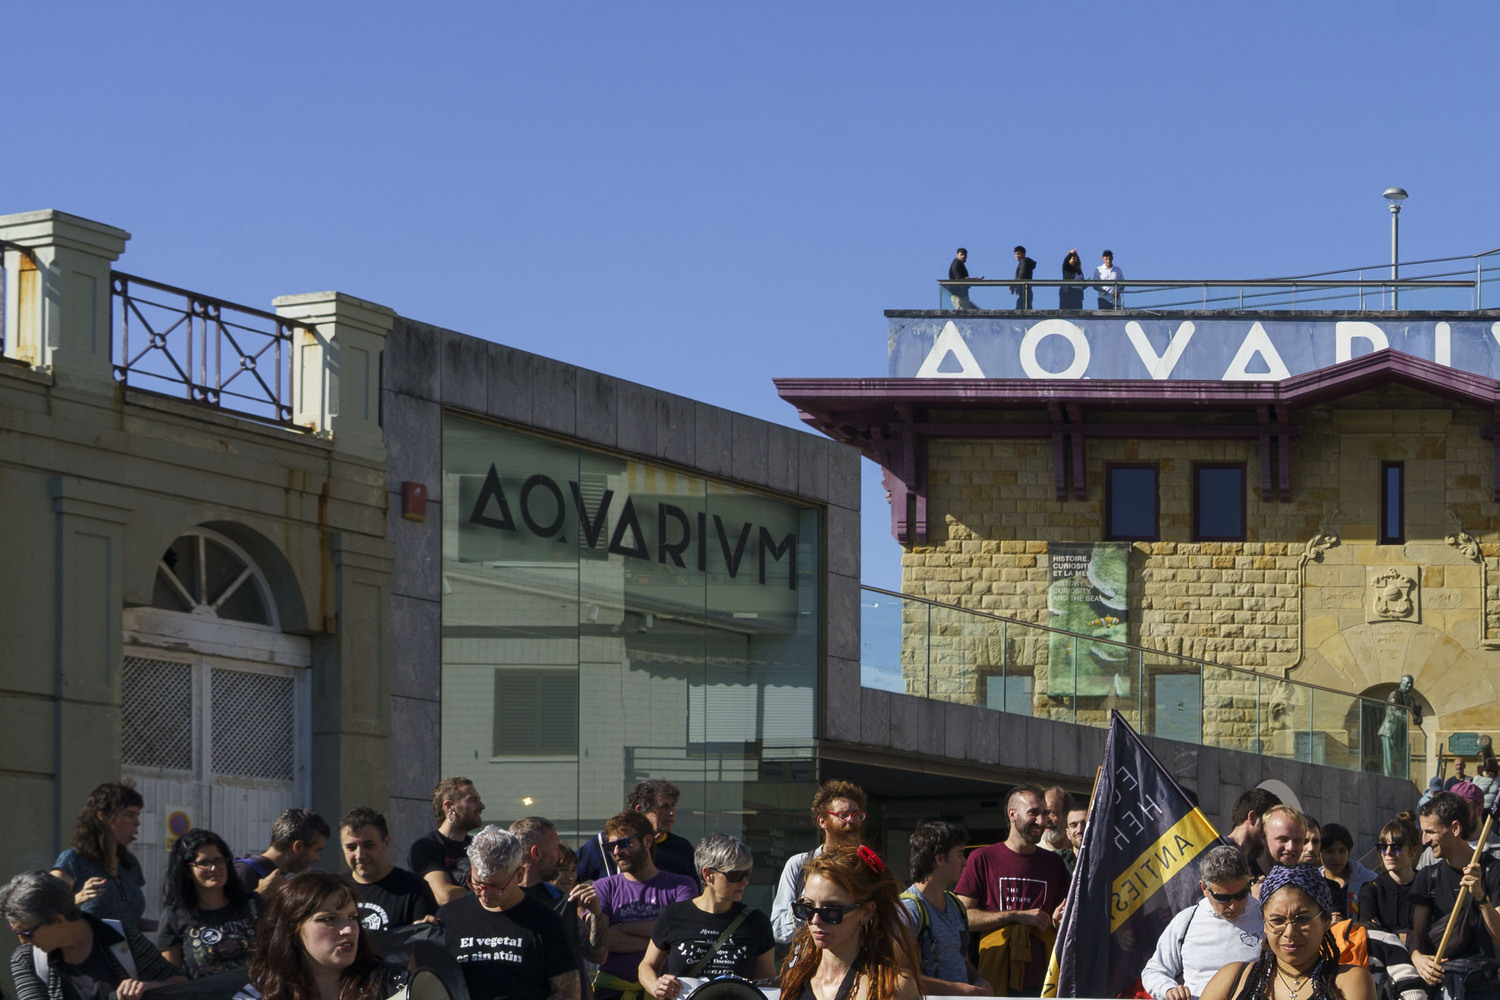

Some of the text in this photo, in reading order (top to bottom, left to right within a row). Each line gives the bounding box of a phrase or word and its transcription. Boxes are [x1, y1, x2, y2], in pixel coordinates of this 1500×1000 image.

[468, 462, 799, 591] AQVARIVM
[1006, 896, 1031, 904] FUTURE
[460, 935, 523, 948] El vegetal
[456, 950, 523, 963] es sin atún
